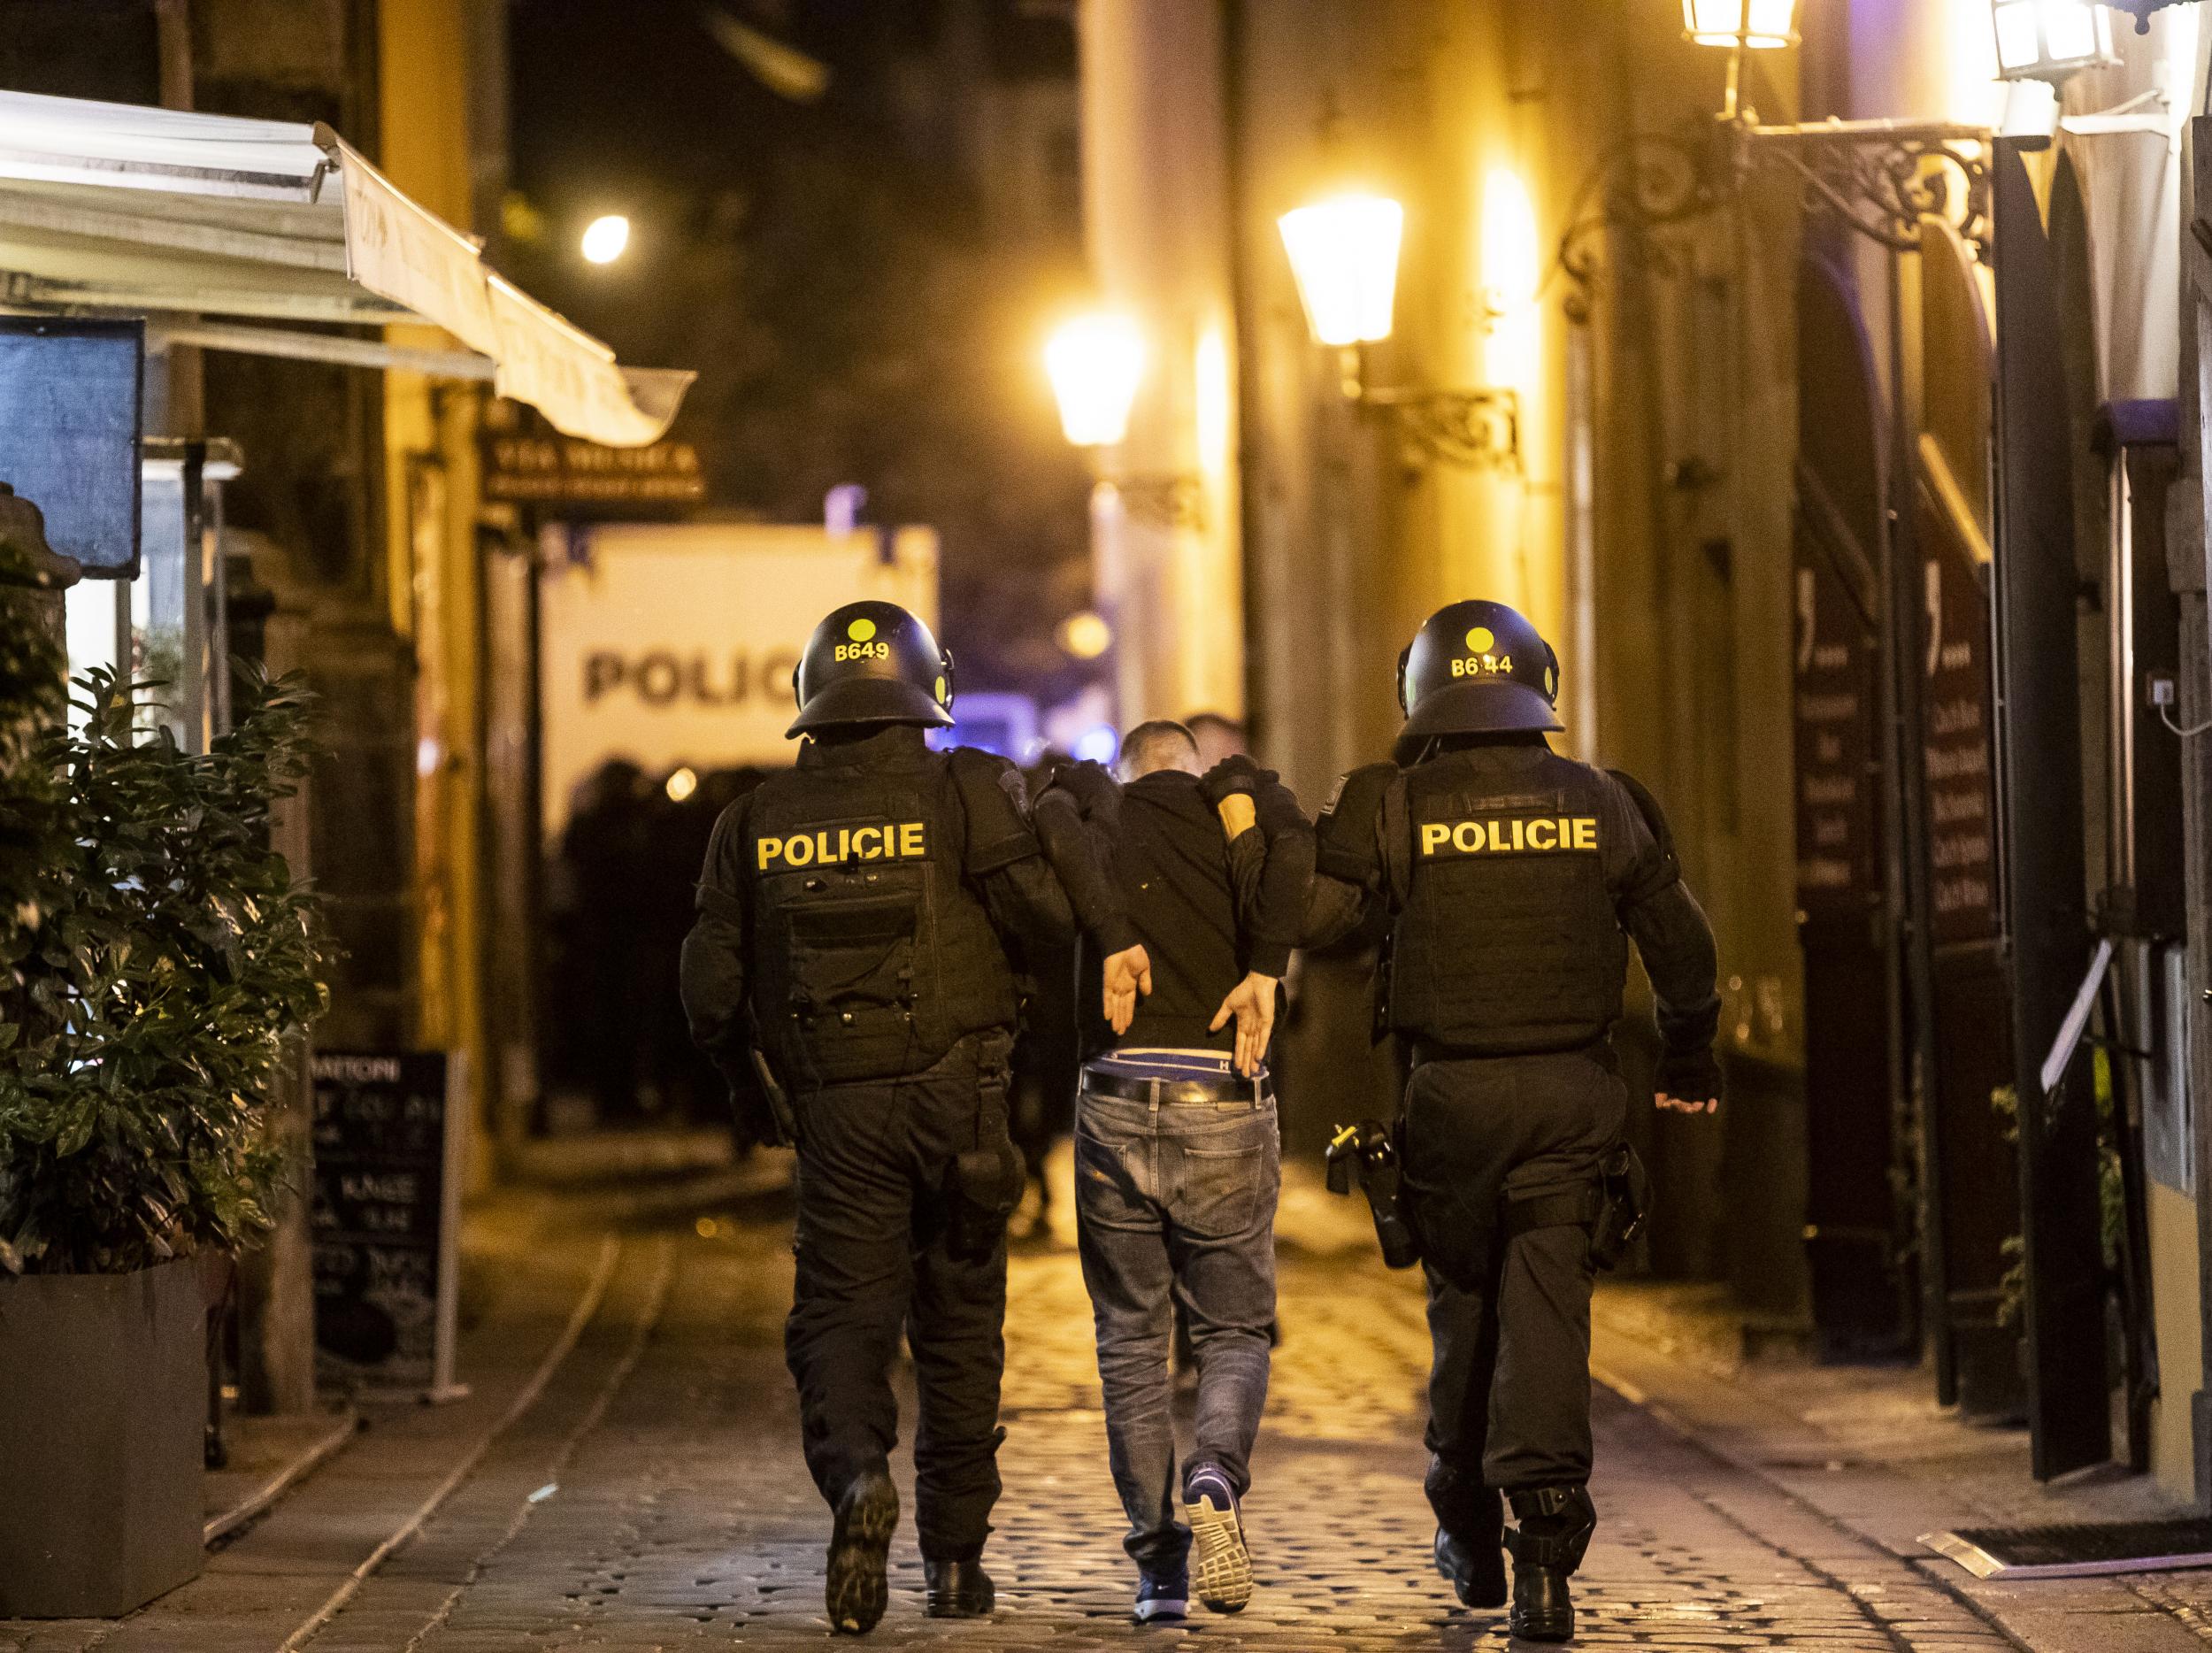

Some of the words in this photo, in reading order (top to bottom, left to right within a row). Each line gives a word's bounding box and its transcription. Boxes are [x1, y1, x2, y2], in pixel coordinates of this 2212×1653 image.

[834, 642, 890, 662] B649
[584, 649, 799, 708] POLIC
[757, 823, 926, 871] POLICIE
[1421, 818, 1598, 856] POLICIE
